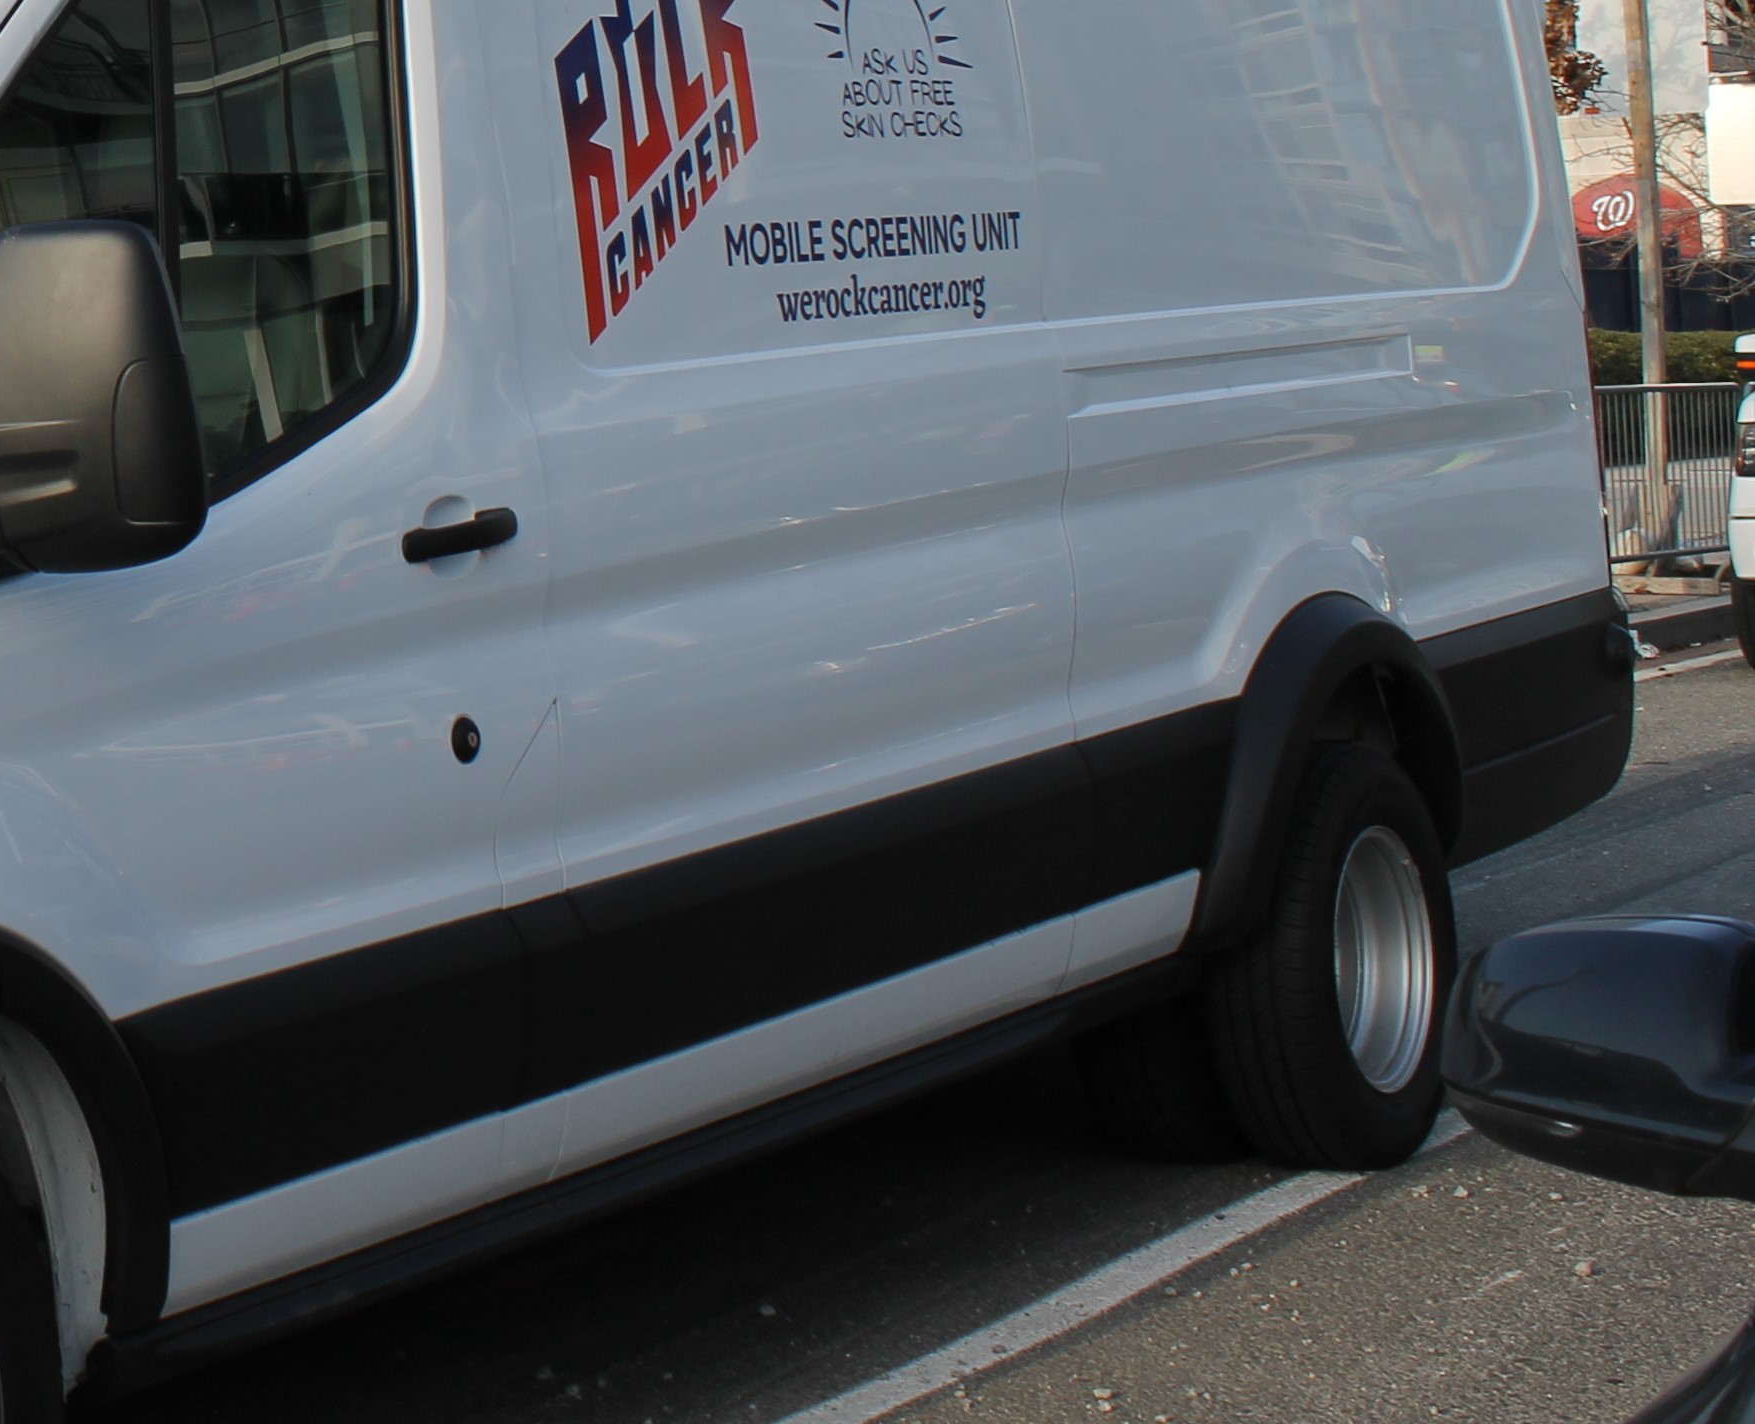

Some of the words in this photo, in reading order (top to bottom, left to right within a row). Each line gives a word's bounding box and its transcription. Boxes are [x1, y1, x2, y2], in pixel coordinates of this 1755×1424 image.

[862, 48, 899, 75] ASK
[902, 48, 929, 75] US
[842, 79, 902, 107] ABOUT
[909, 79, 956, 106] FREE
[841, 111, 885, 138] SKIN
[889, 110, 963, 137] CHECKS
[607, 97, 742, 318] CANCER
[724, 219, 825, 267] MOBILE
[830, 213, 966, 261] SCREENING
[972, 210, 1021, 252] UNIT
[776, 273, 986, 322] werockcancer.org
